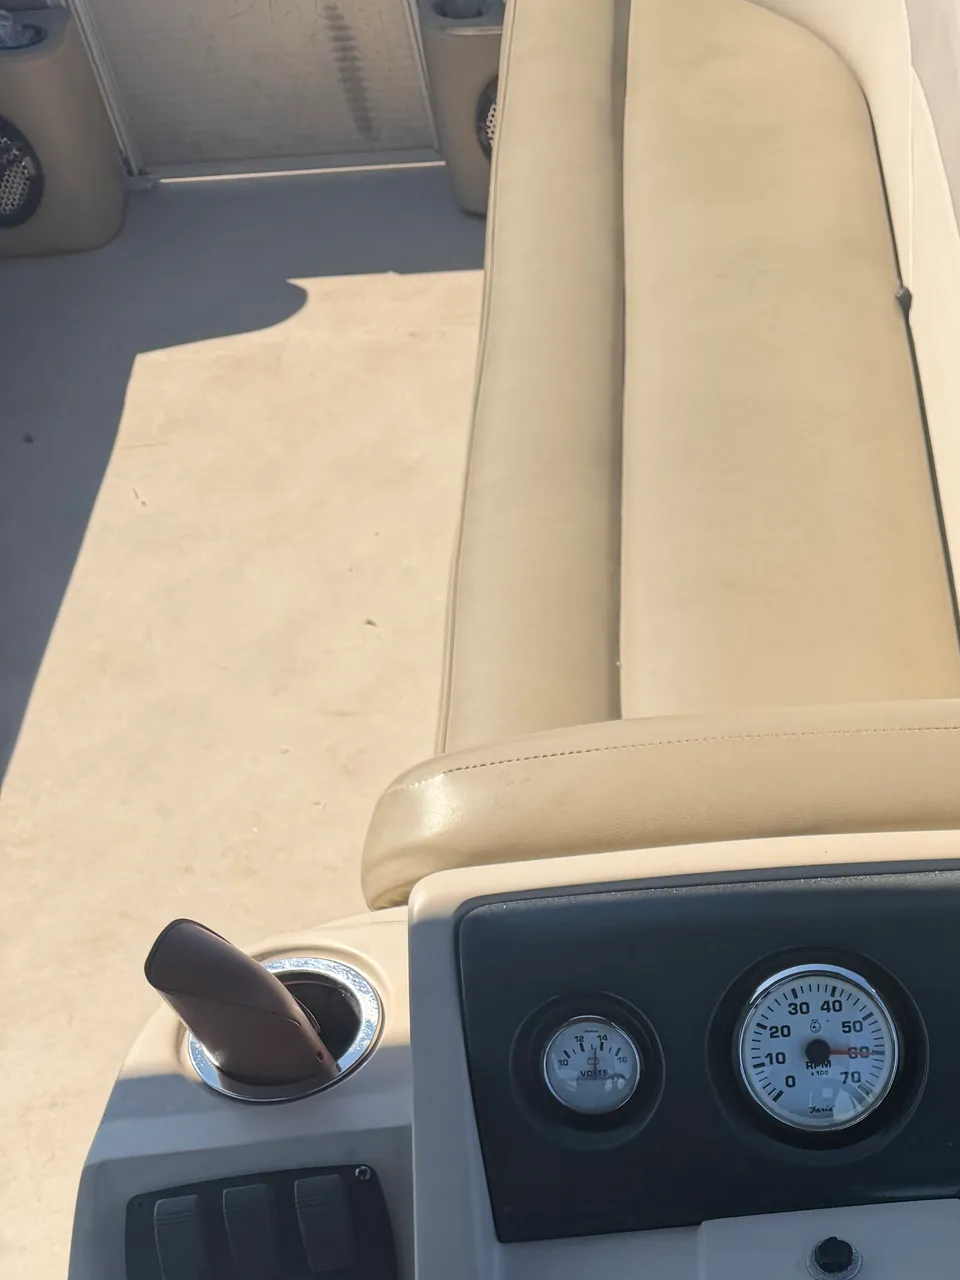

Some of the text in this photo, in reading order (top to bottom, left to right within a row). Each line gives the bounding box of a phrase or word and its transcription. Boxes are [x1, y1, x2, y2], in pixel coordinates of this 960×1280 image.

[788, 1002, 810, 1015] 30
[821, 1000, 842, 1013] 40
[769, 1025, 791, 1038] 20
[842, 1020, 863, 1033] 50
[765, 1052, 786, 1065] 10
[848, 1046, 870, 1059] 60
[558, 1059, 569, 1067] 10
[806, 1060, 831, 1070] RPM
[785, 1076, 796, 1088] 0
[840, 1071, 861, 1084] 70
